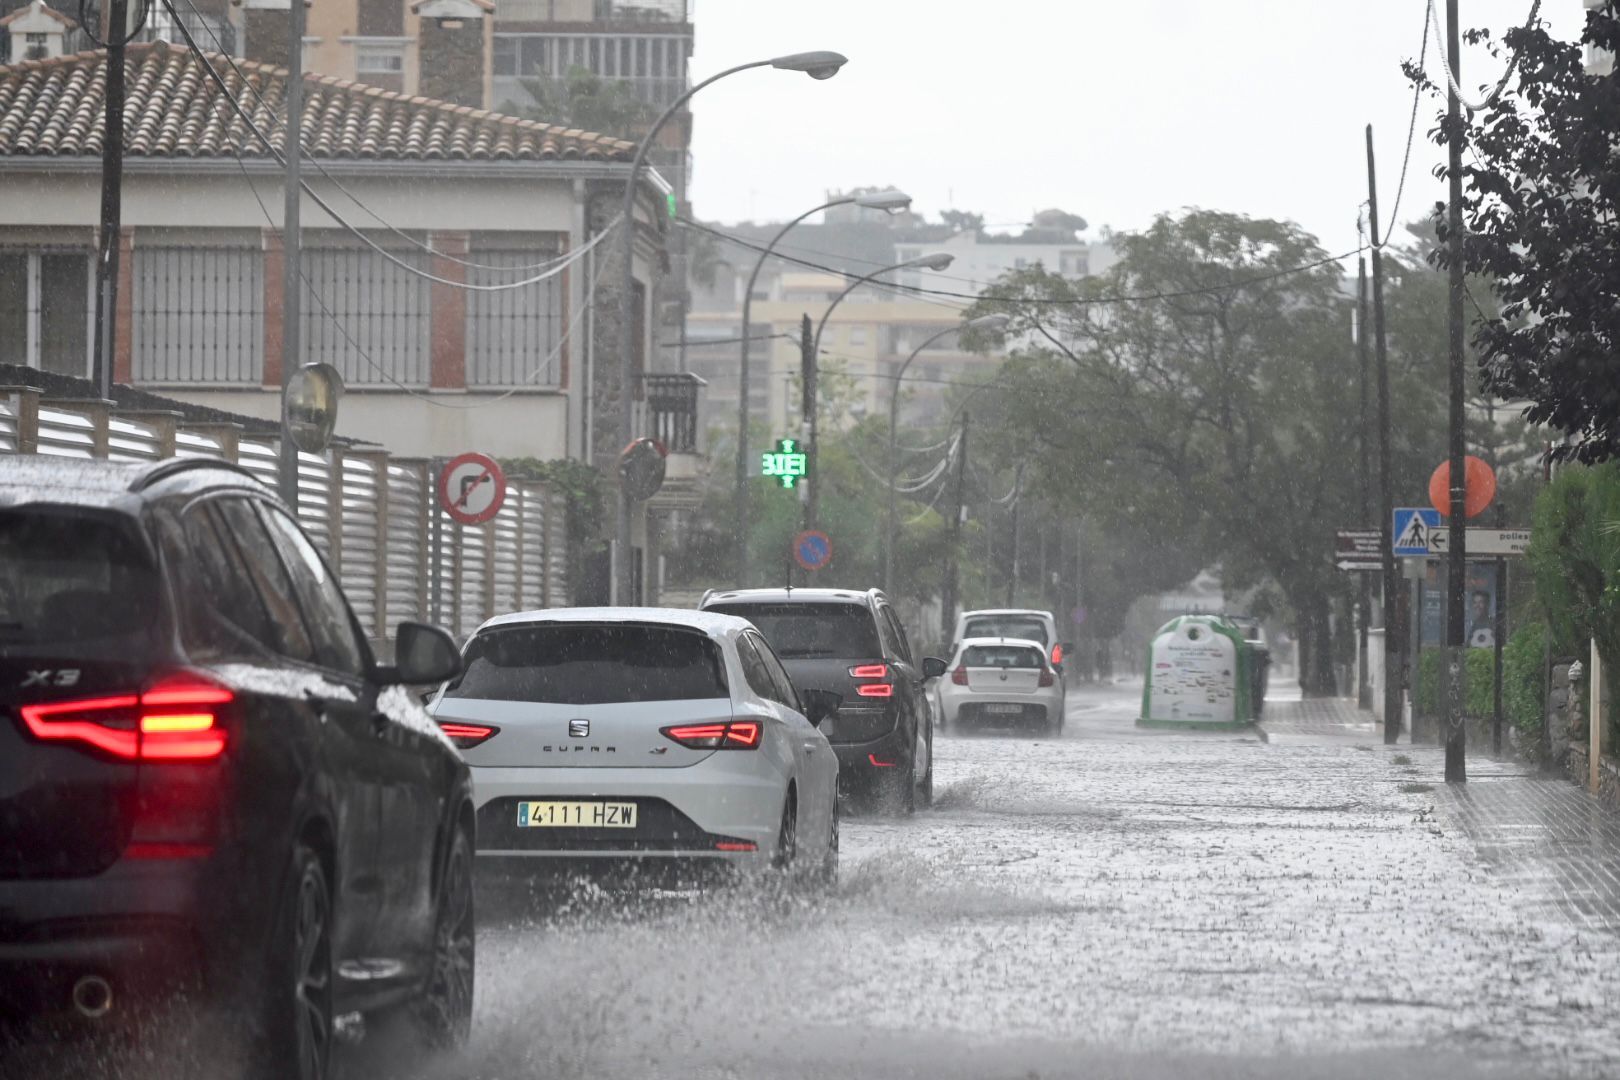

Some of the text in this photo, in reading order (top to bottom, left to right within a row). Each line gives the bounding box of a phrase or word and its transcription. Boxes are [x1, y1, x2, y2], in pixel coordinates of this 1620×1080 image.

[21, 669, 80, 686] X3
[543, 745, 616, 753] CUPRA
[532, 805, 633, 825] 4111 HZW
